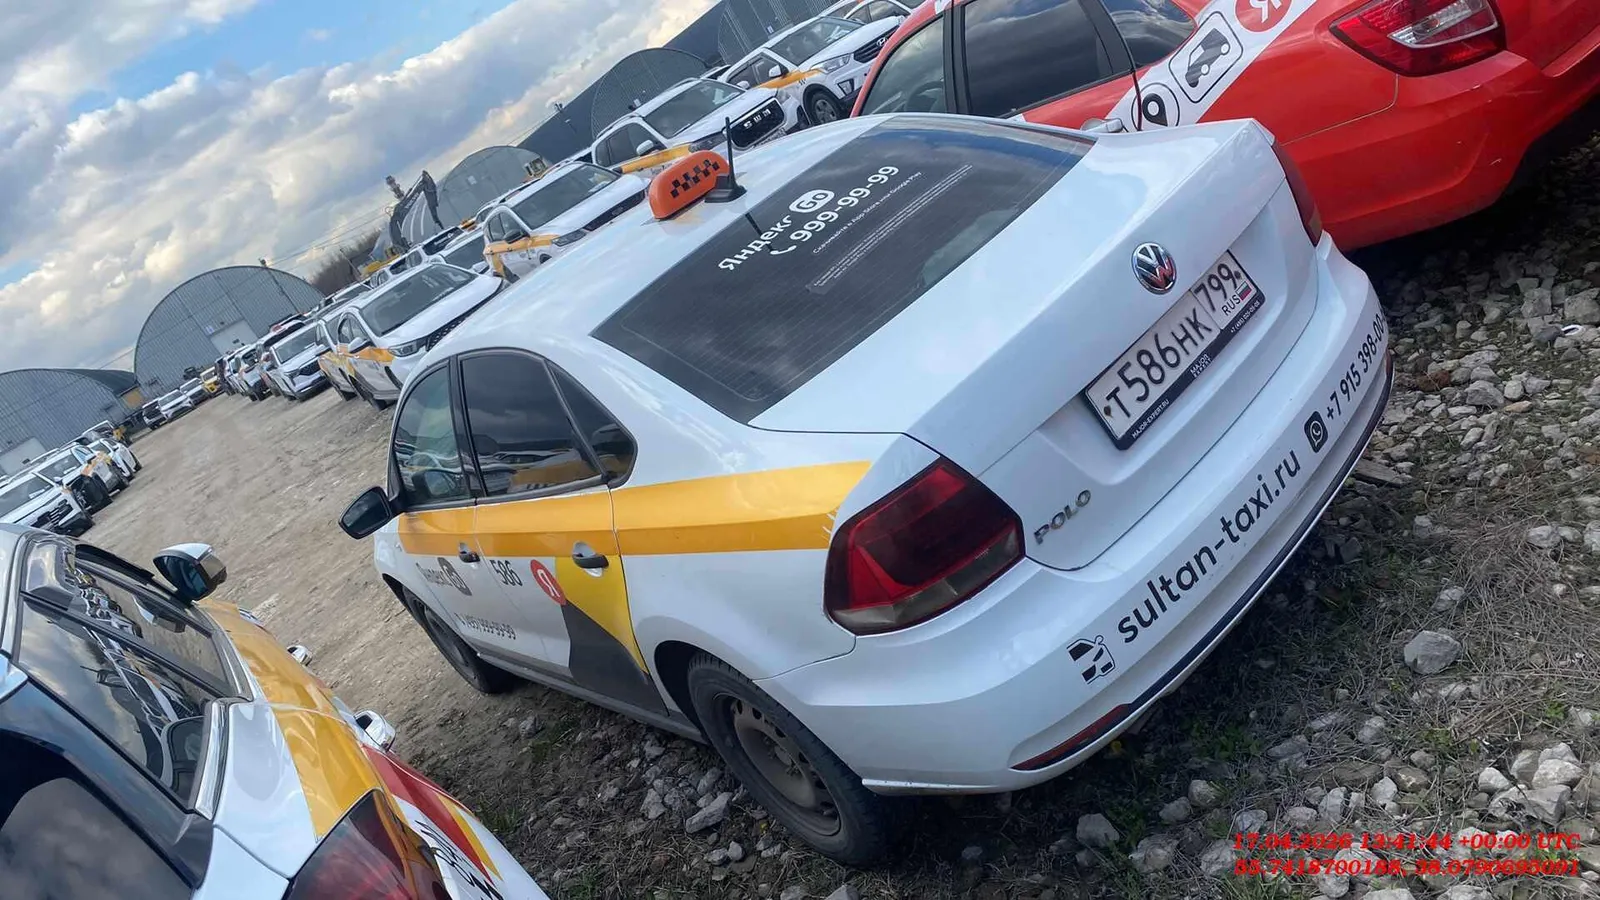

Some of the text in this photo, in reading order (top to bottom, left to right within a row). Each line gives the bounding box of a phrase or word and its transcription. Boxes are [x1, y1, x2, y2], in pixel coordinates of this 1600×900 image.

[789, 166, 899, 242] 999-99-99
[1194, 263, 1238, 313] 799
[1221, 294, 1241, 317] RUS
[1189, 353, 1209, 374] MAJOR
[1034, 490, 1091, 545] POLO
[1118, 450, 1301, 643] sultan-taxi.ru
[1326, 391, 1341, 420] +7
[1340, 362, 1361, 402] 915
[489, 559, 523, 587] 586
